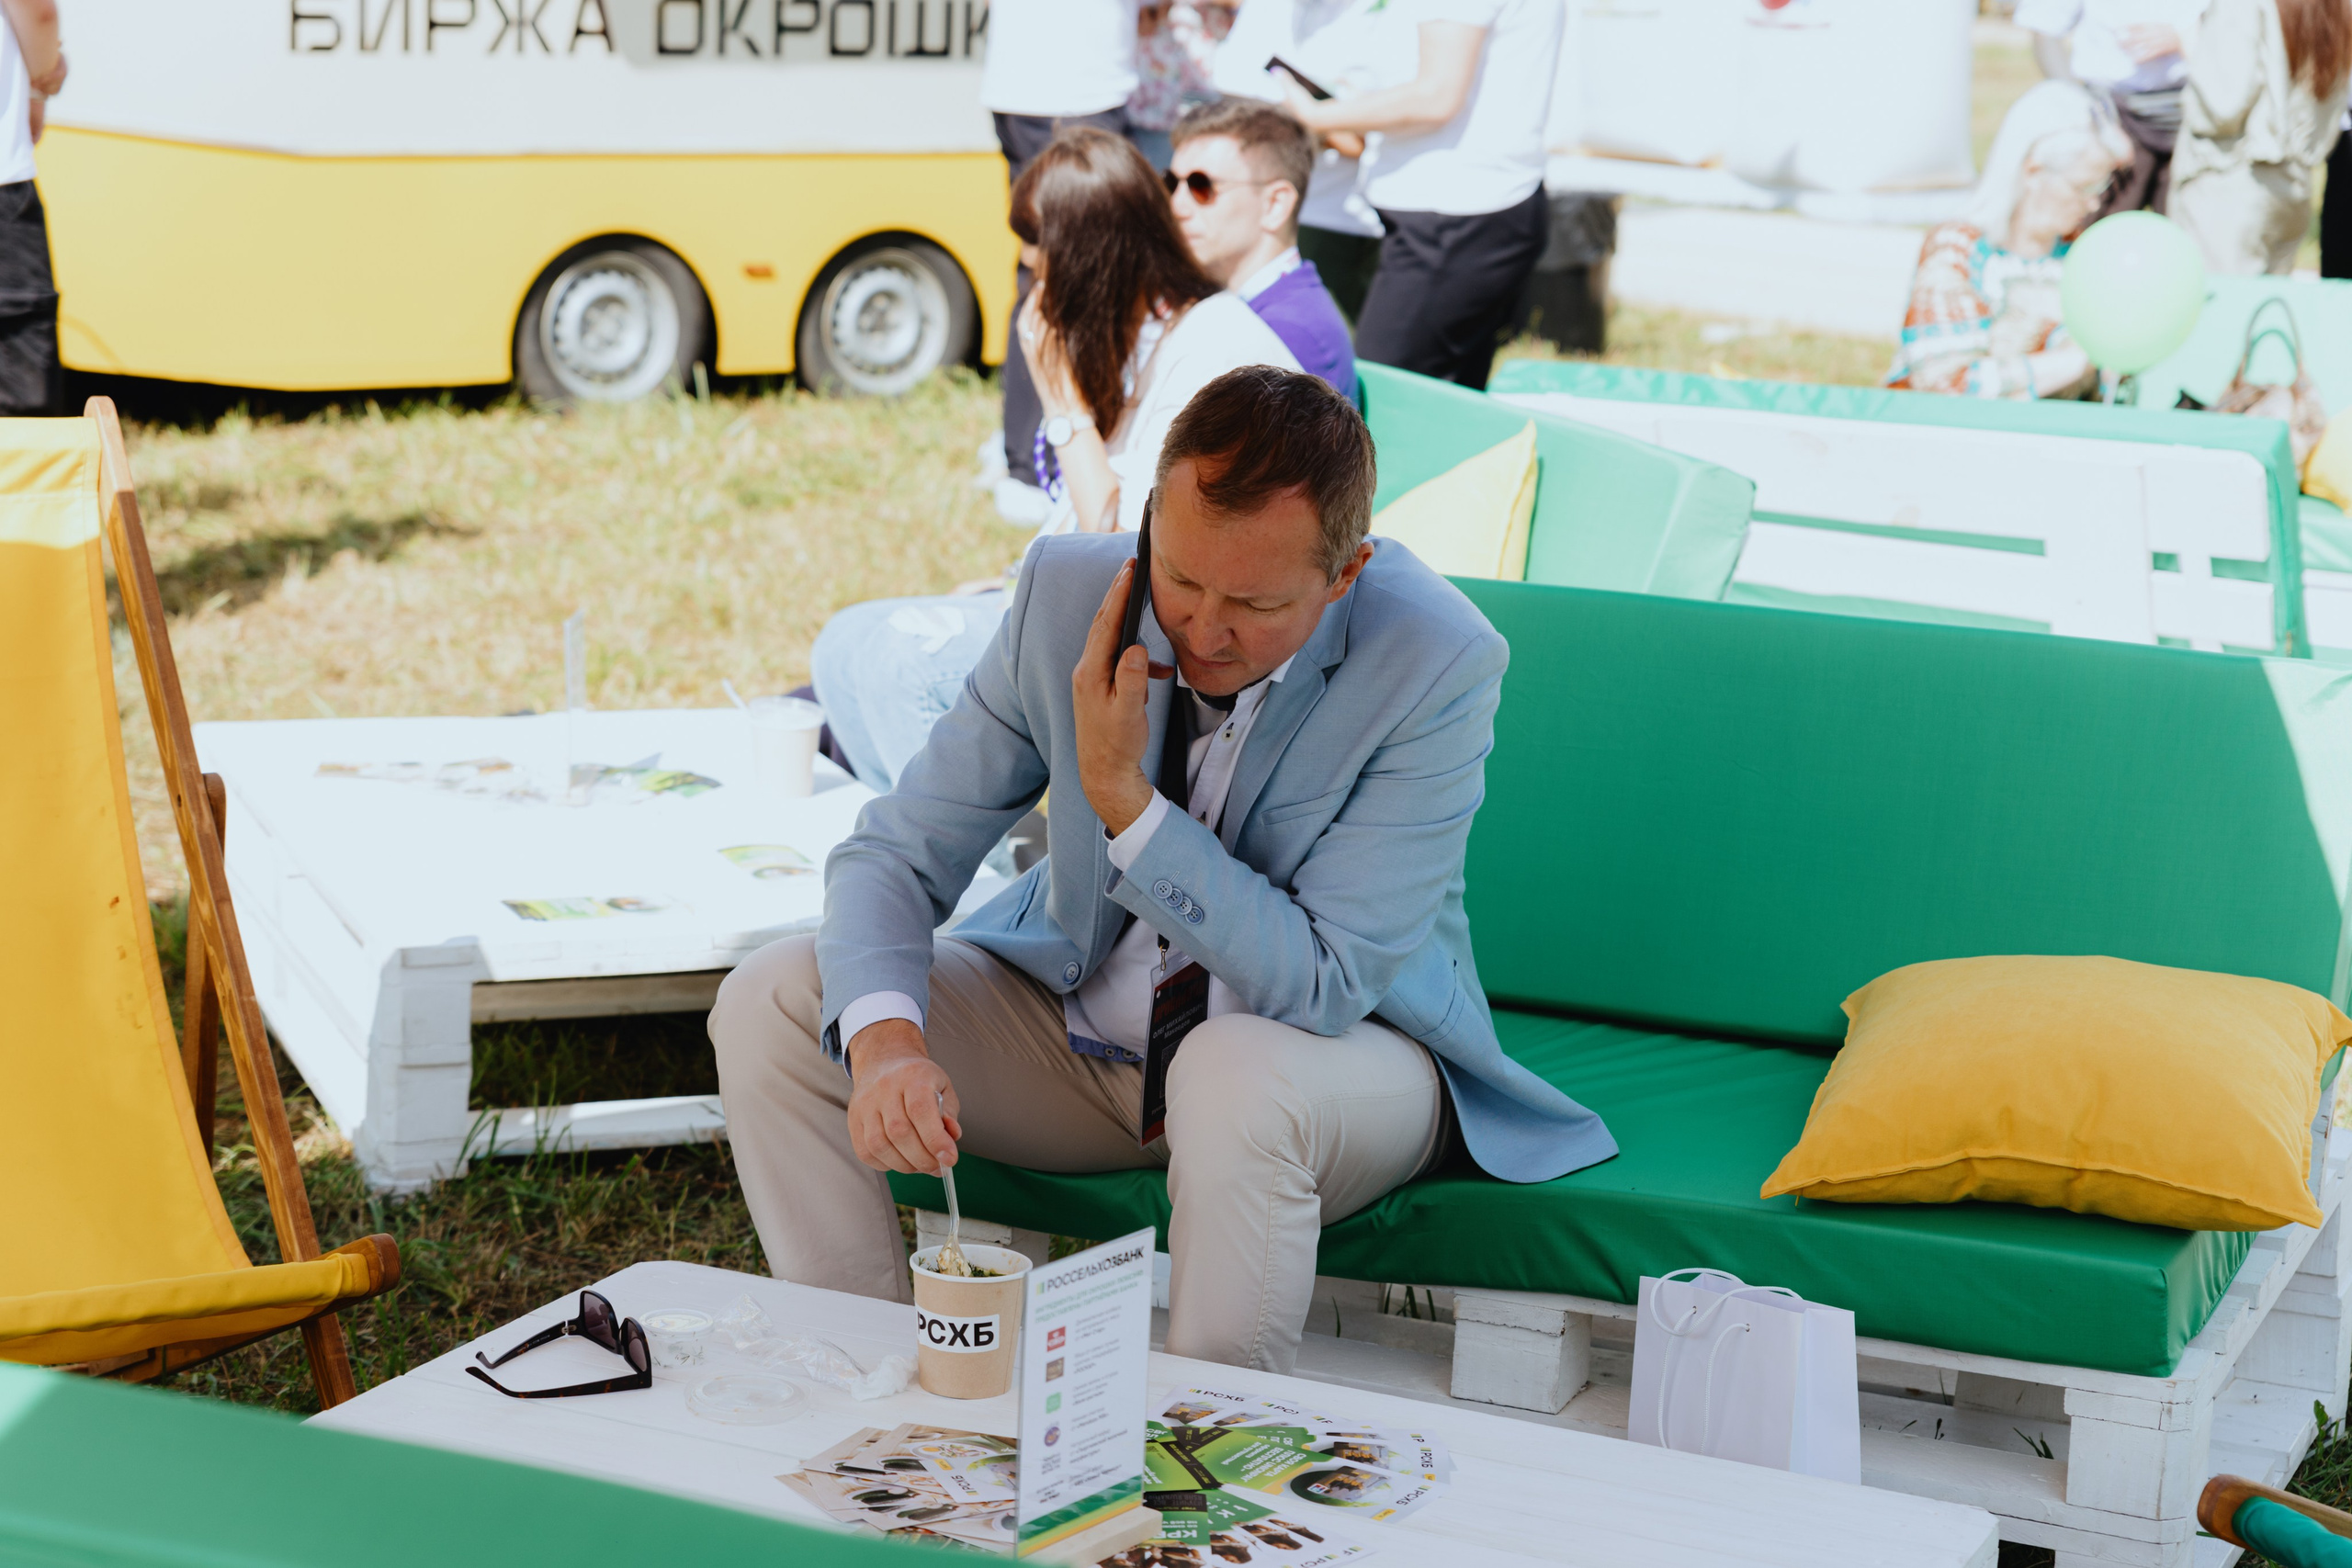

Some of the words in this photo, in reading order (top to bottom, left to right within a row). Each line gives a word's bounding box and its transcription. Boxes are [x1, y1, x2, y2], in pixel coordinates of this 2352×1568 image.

[288, 0, 615, 53] БИРЖА
[1046, 1246, 1145, 1292] РОССЕЛЬХОЗБАНК
[917, 1311, 995, 1348] РСХБ
[1203, 1390, 1246, 1403] РСХБ
[1420, 1451, 1433, 1469] РСХБ
[1396, 1488, 1425, 1506] РСХБ
